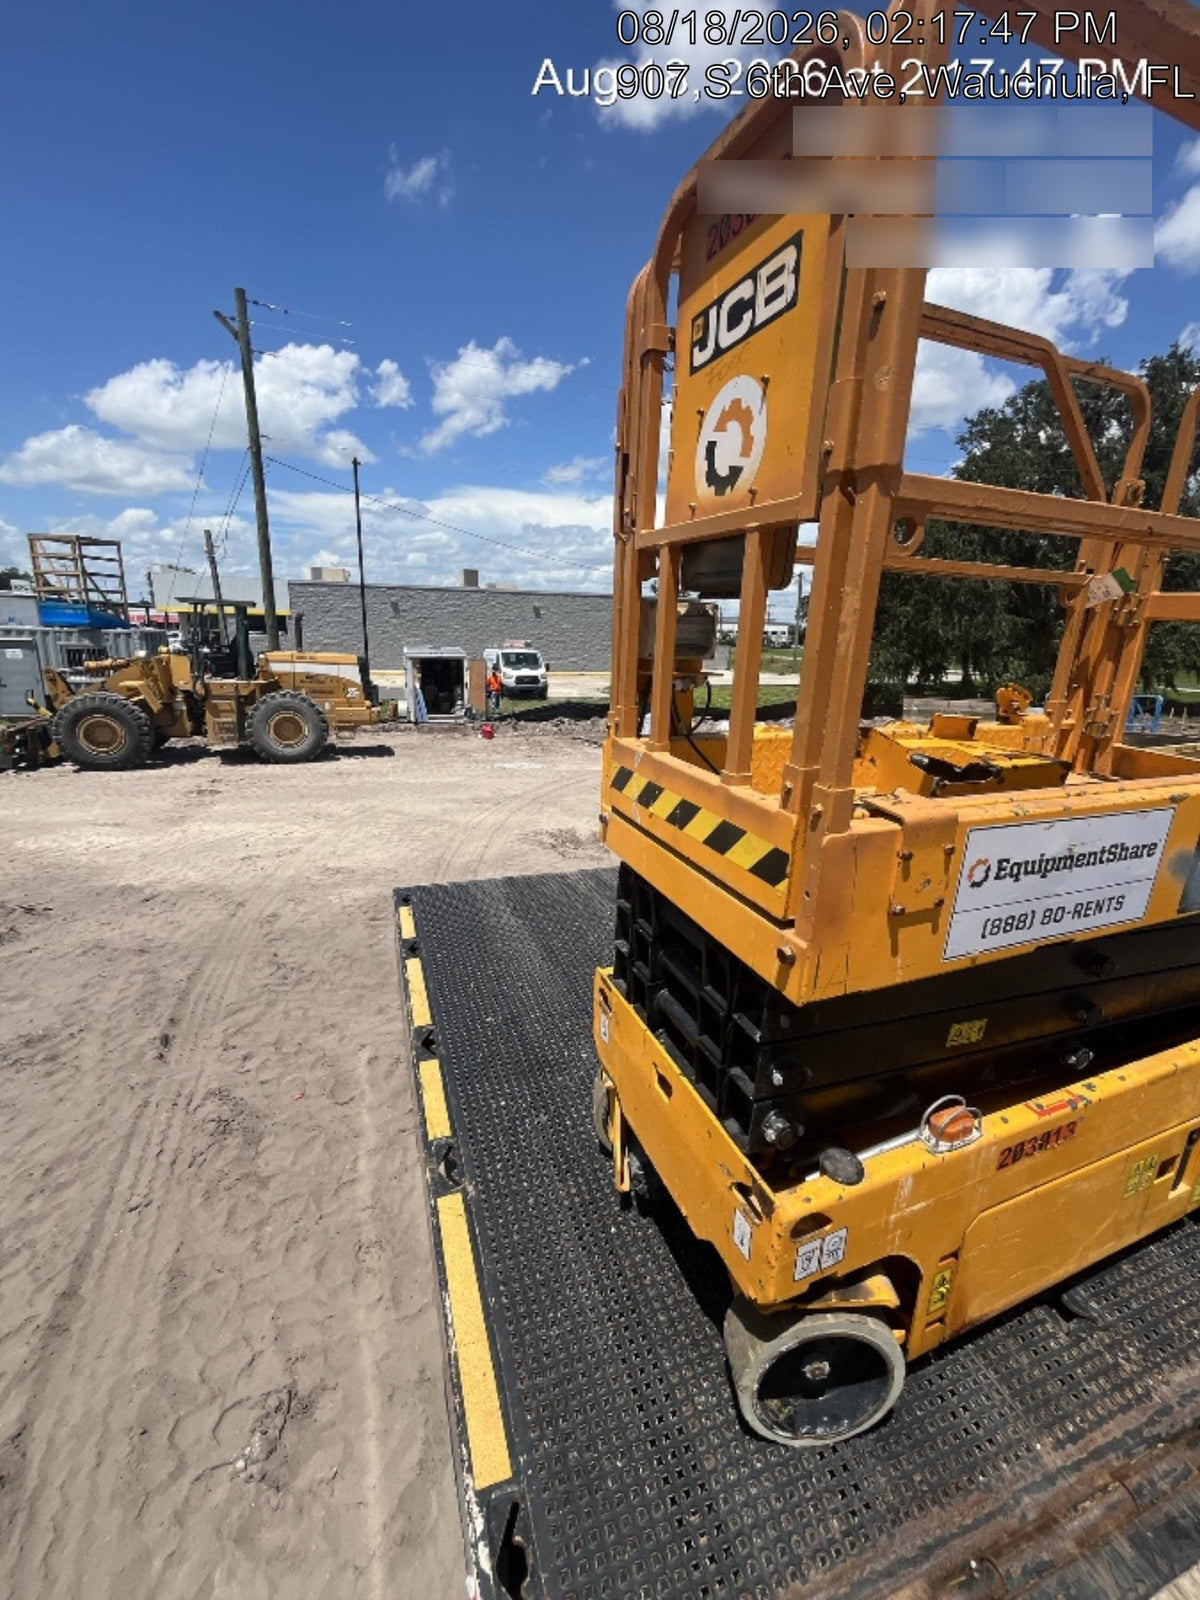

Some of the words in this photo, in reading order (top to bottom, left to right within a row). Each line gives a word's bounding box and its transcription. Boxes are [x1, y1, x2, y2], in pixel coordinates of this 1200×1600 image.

[692, 244, 799, 367] JCB
[993, 842, 1159, 882] EquipmentShare
[981, 910, 1036, 939] (888)
